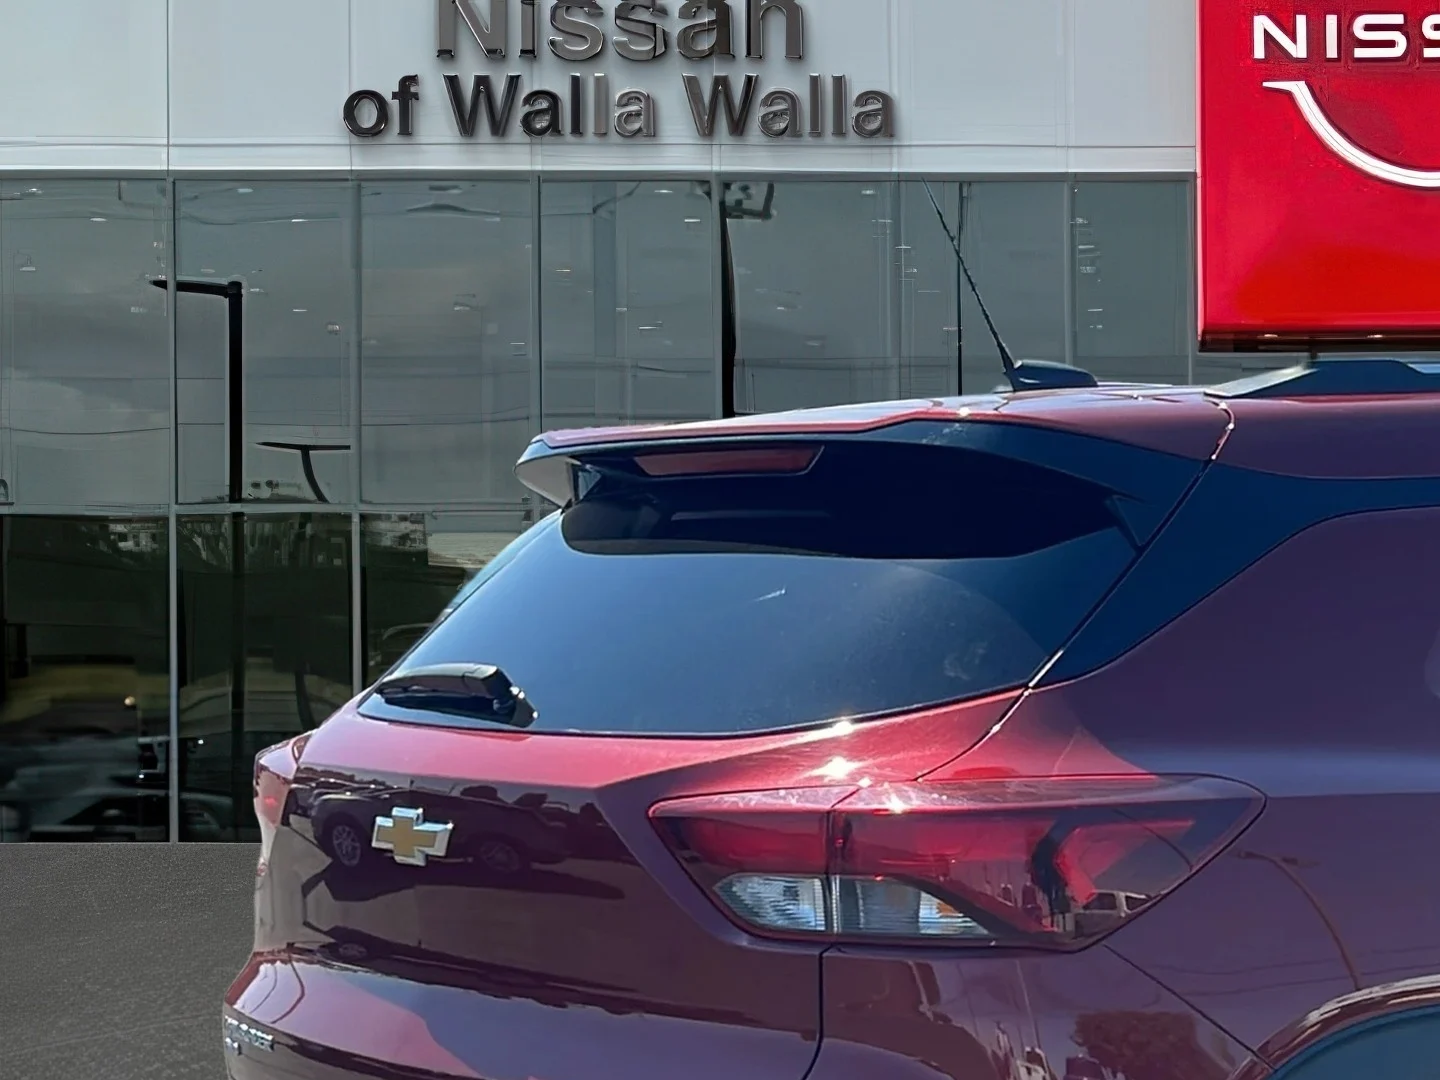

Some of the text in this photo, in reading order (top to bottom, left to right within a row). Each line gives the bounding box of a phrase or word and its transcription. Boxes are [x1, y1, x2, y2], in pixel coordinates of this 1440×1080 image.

[434, 0, 805, 61] Nissan
[342, 72, 894, 138] of Walla Walla
